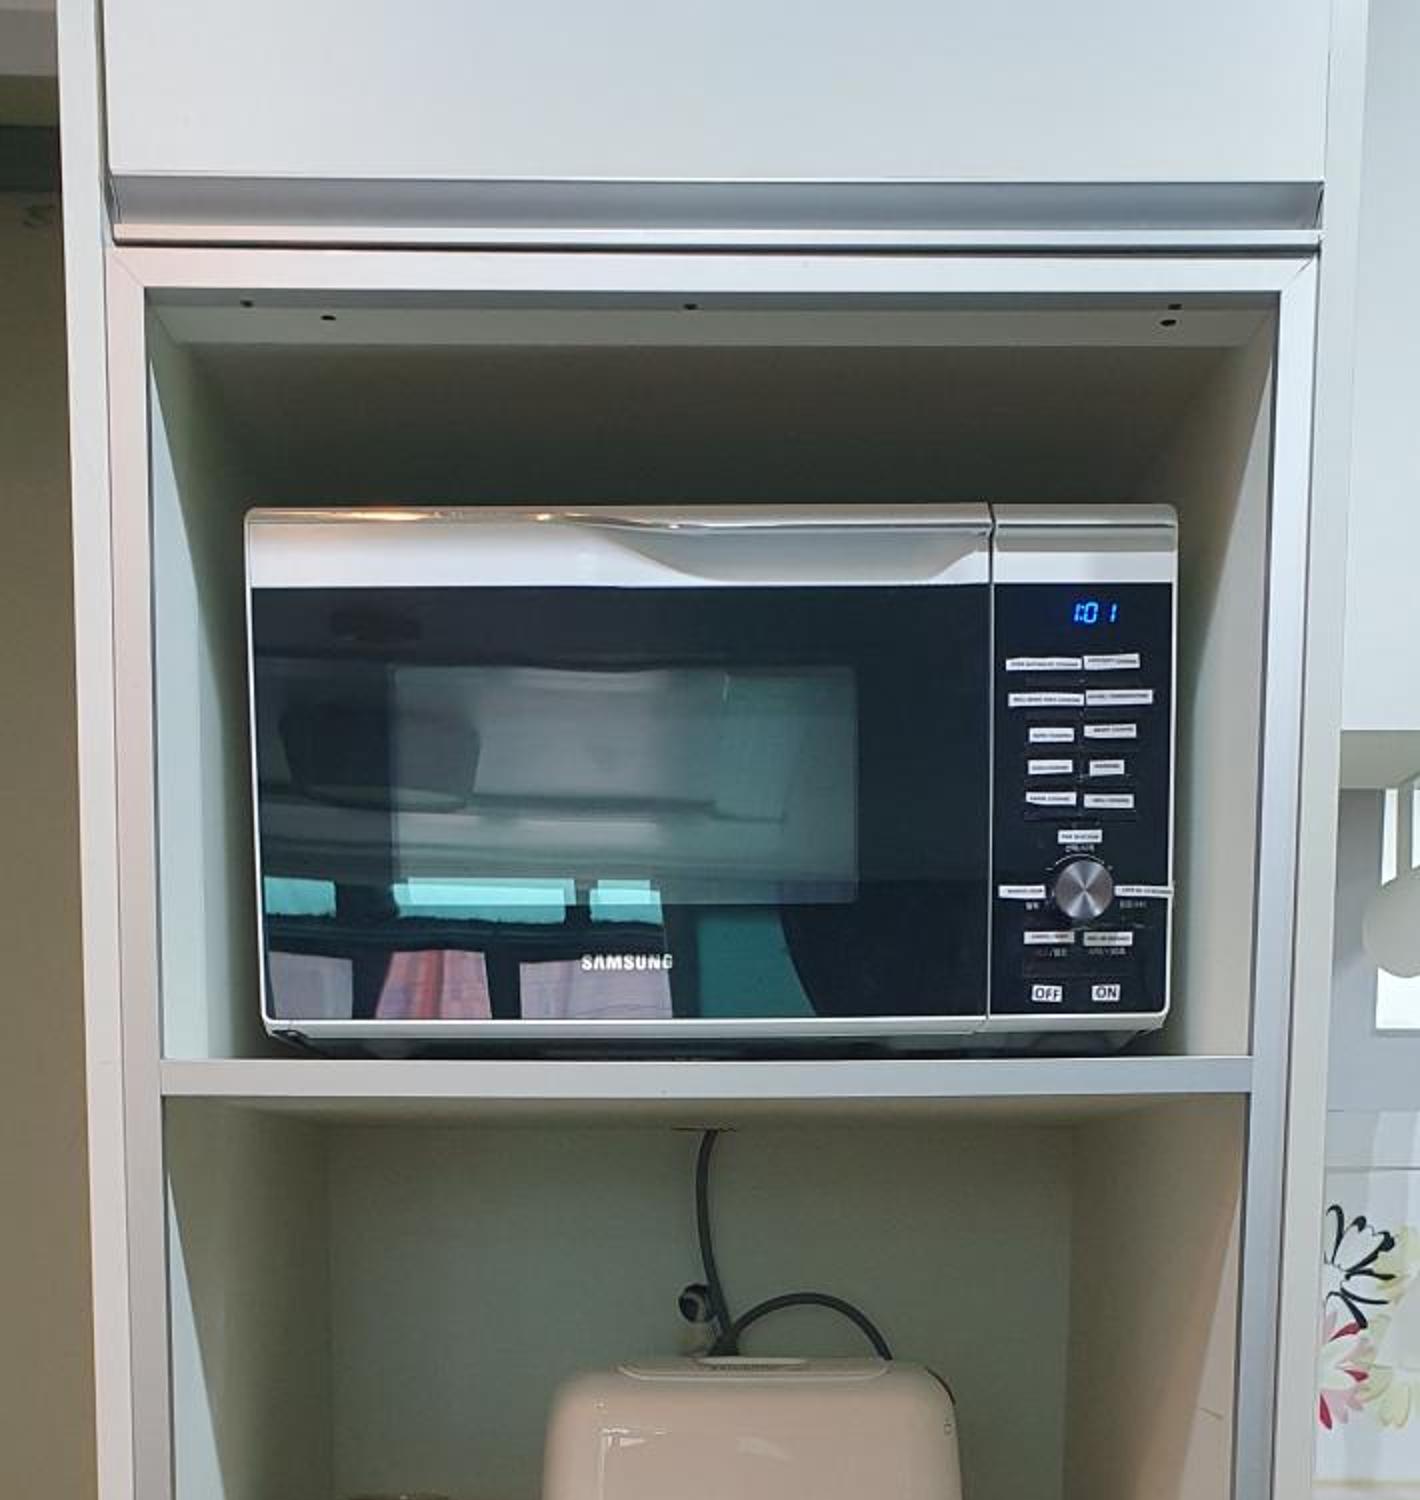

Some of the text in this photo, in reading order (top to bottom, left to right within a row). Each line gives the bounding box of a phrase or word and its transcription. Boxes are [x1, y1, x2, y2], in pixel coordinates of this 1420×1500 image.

[1073, 601, 1118, 623] 1:01
[580, 953, 673, 970] SAMSUNG
[1035, 987, 1061, 1000] OFF
[1095, 987, 1117, 999] ON
